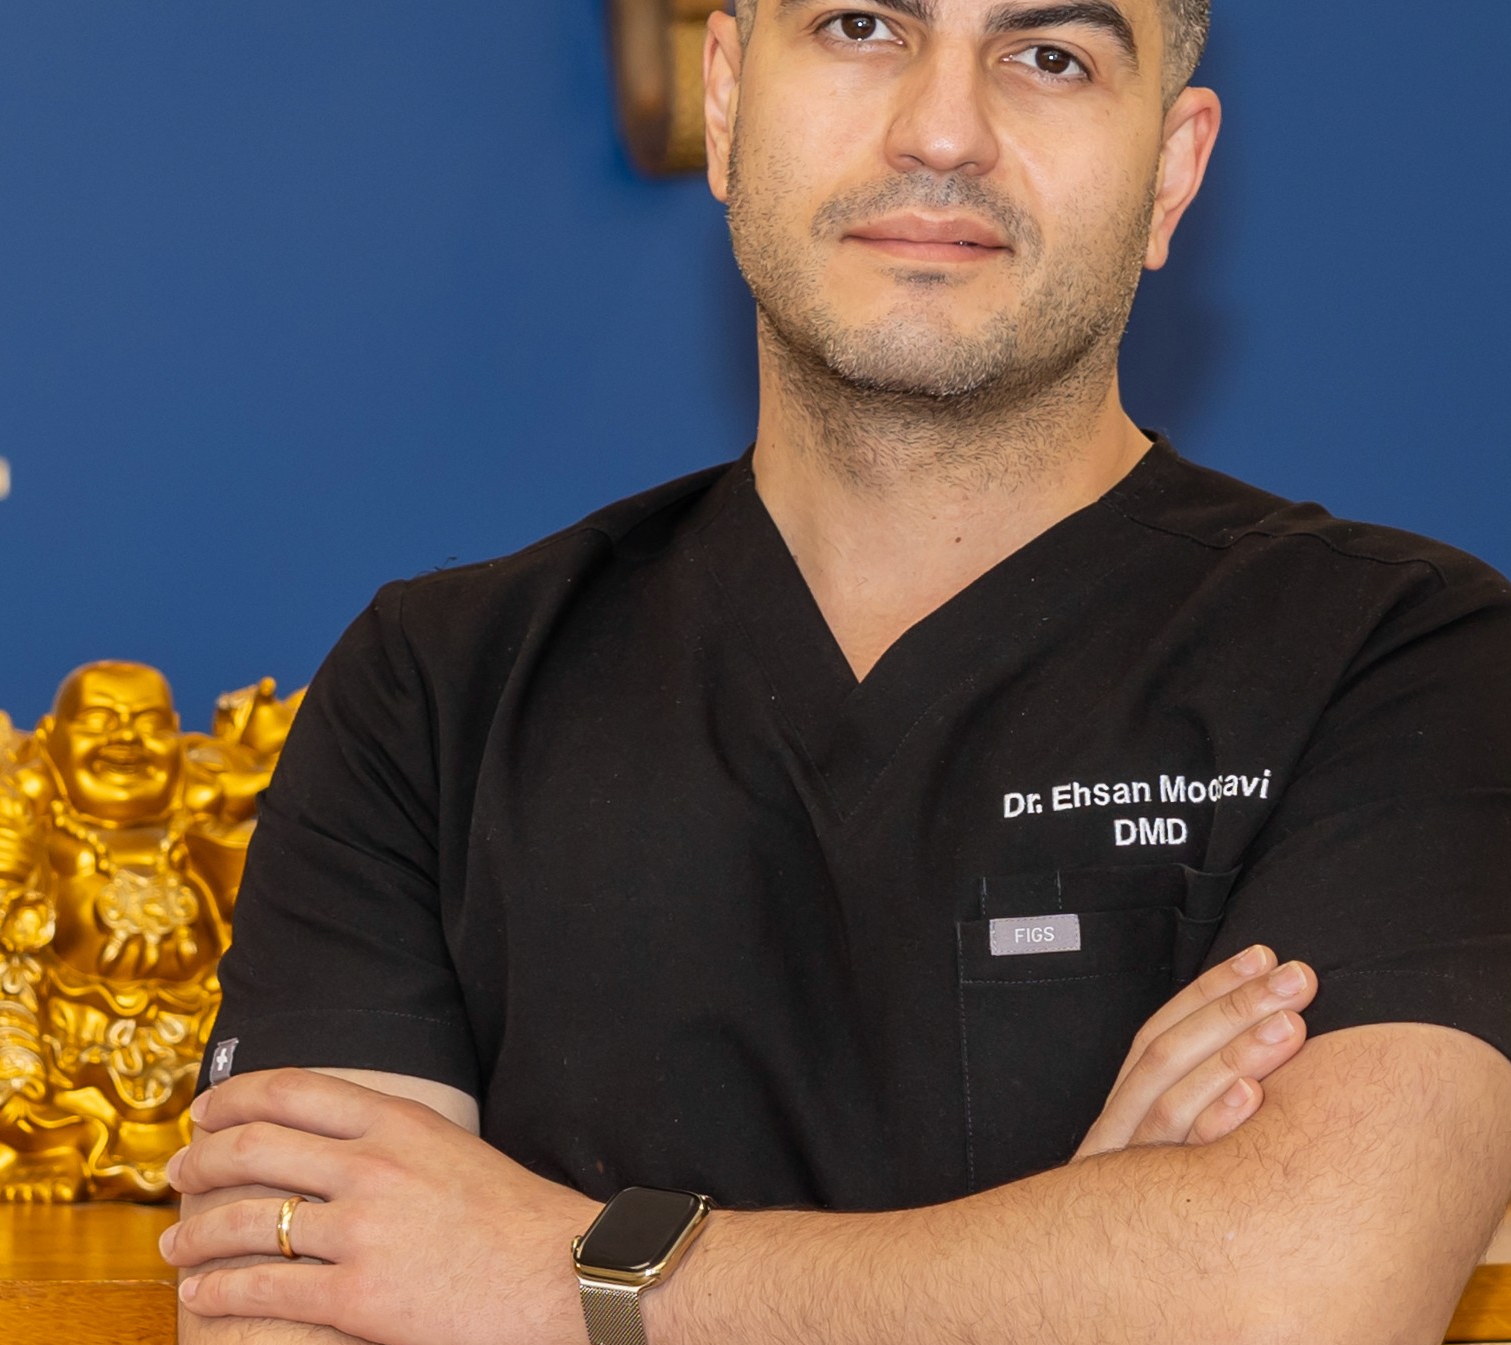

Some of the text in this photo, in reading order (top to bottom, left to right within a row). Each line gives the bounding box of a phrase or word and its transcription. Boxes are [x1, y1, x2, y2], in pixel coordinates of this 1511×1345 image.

[1003, 792, 1043, 819] Dr.
[1052, 781, 1152, 812] Ehsan
[1114, 817, 1188, 846] DMD
[1014, 926, 1056, 944] FIGS
